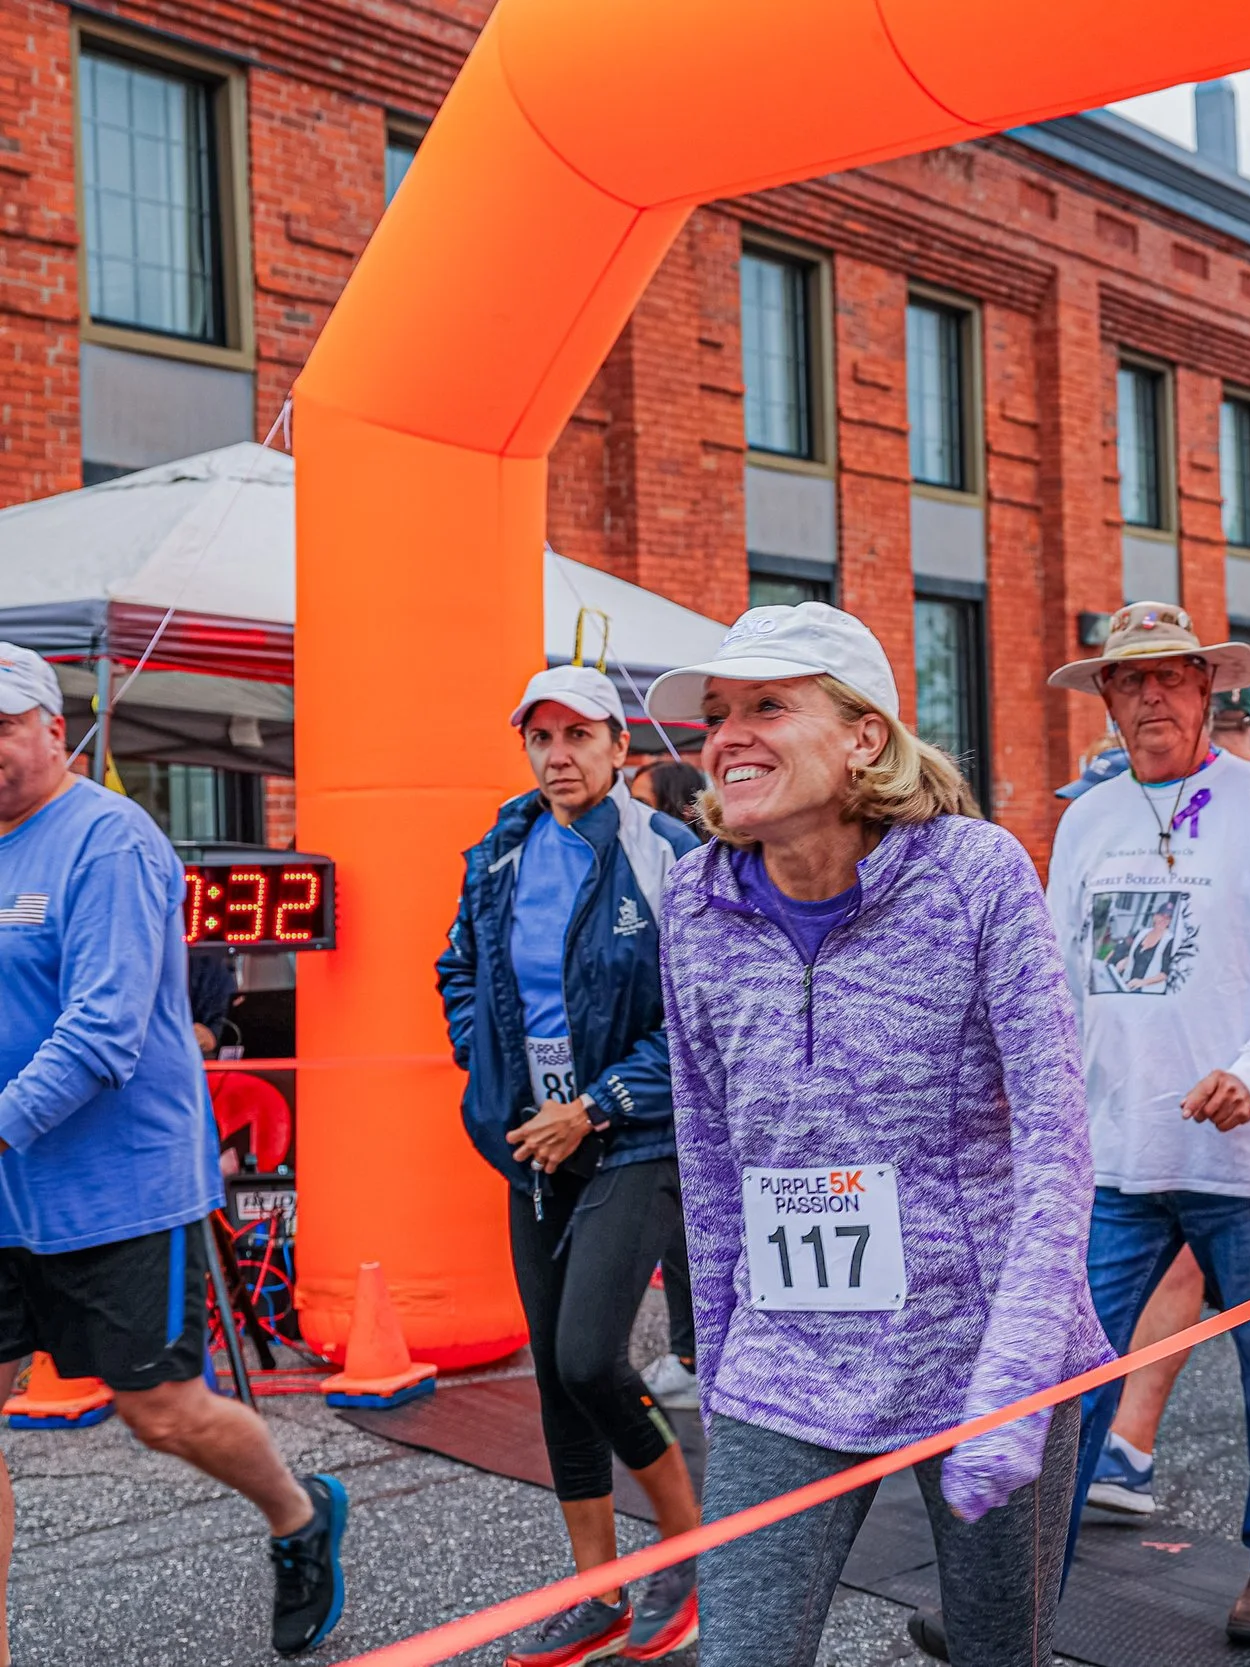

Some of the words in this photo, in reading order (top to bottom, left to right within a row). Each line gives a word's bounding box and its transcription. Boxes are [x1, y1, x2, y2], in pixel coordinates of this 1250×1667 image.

[1170, 872, 1212, 887] PARKER
[528, 1042, 567, 1054] PURPLE
[760, 1177, 828, 1195] PURPLE
[829, 1170, 866, 1194] 5K
[776, 1194, 860, 1214] PASSION
[768, 1224, 870, 1288] 117
